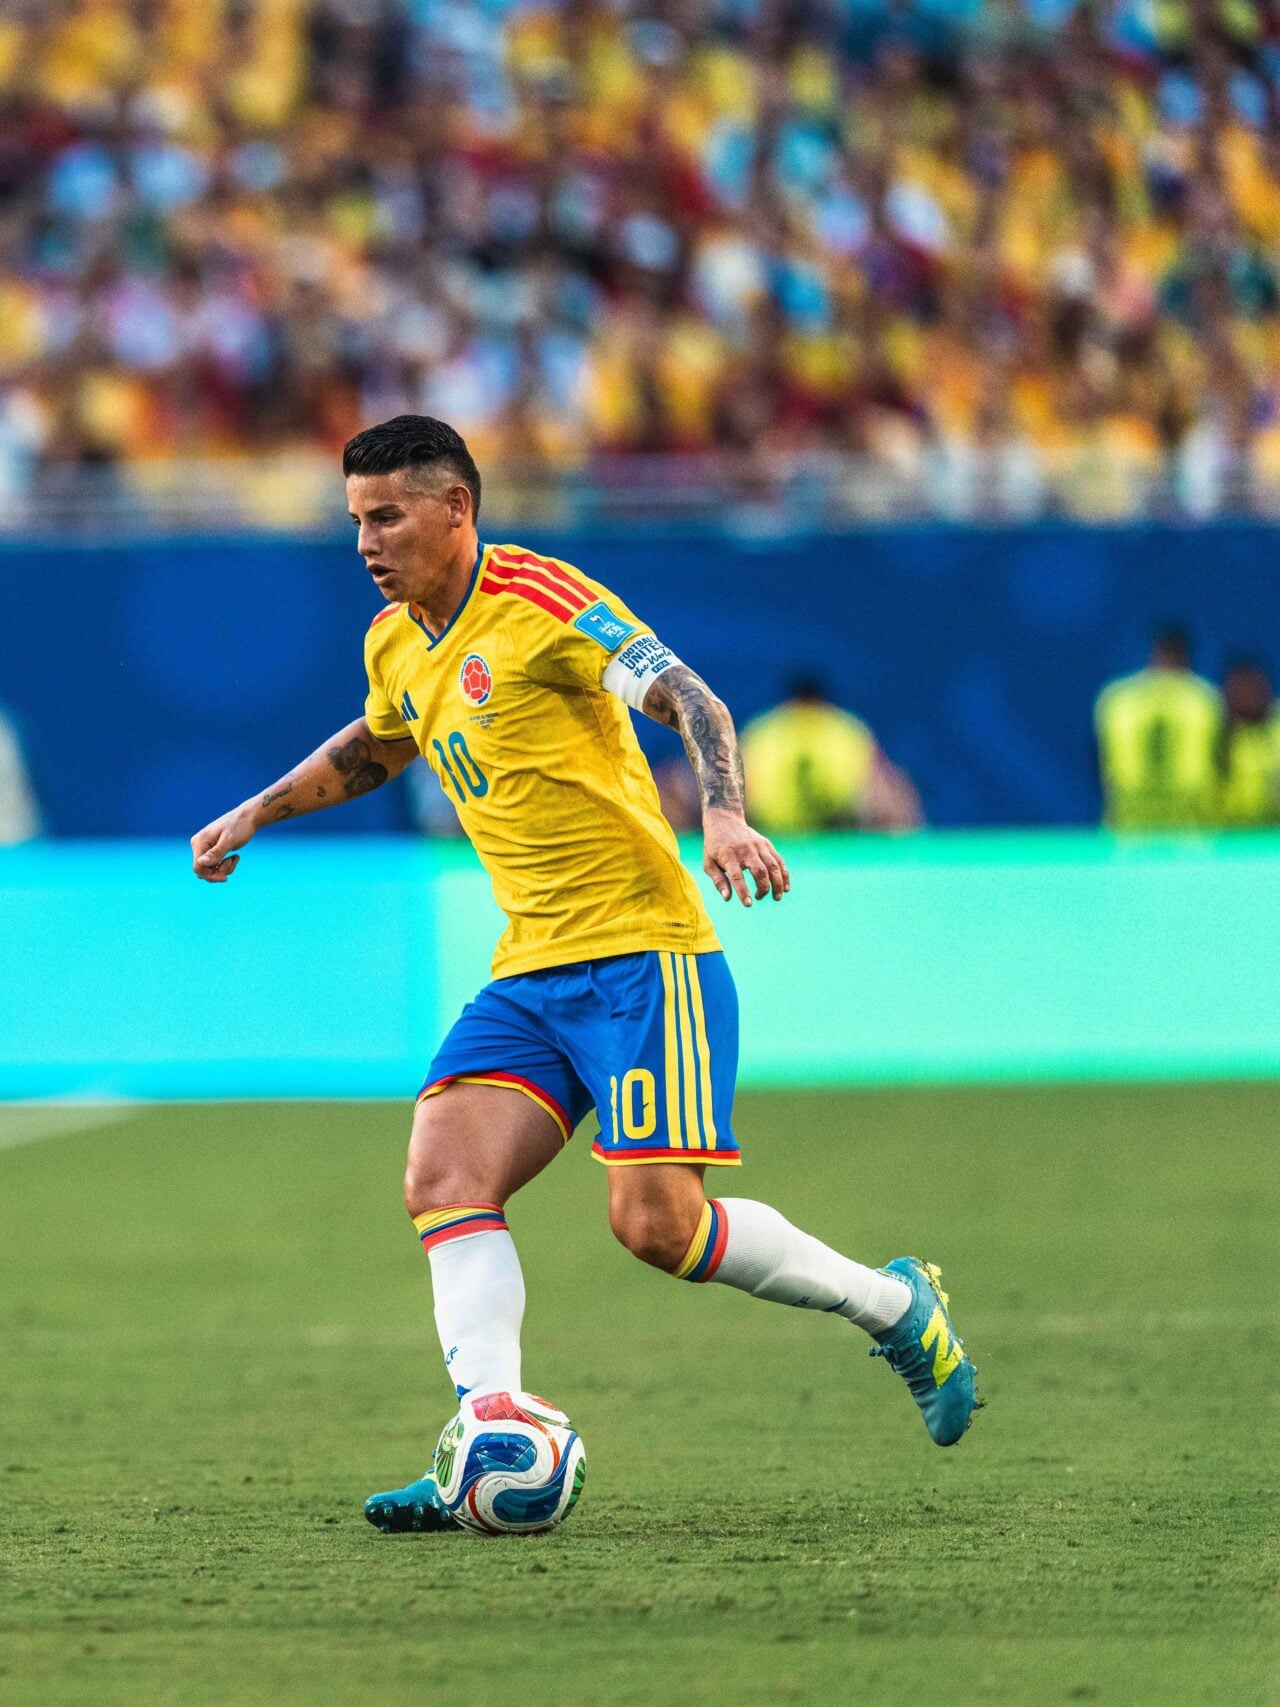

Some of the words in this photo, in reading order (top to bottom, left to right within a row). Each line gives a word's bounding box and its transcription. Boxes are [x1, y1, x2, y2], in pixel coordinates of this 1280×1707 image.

[634, 664, 649, 678] the
[432, 731, 489, 803] 10
[610, 1068, 657, 1144] 10
